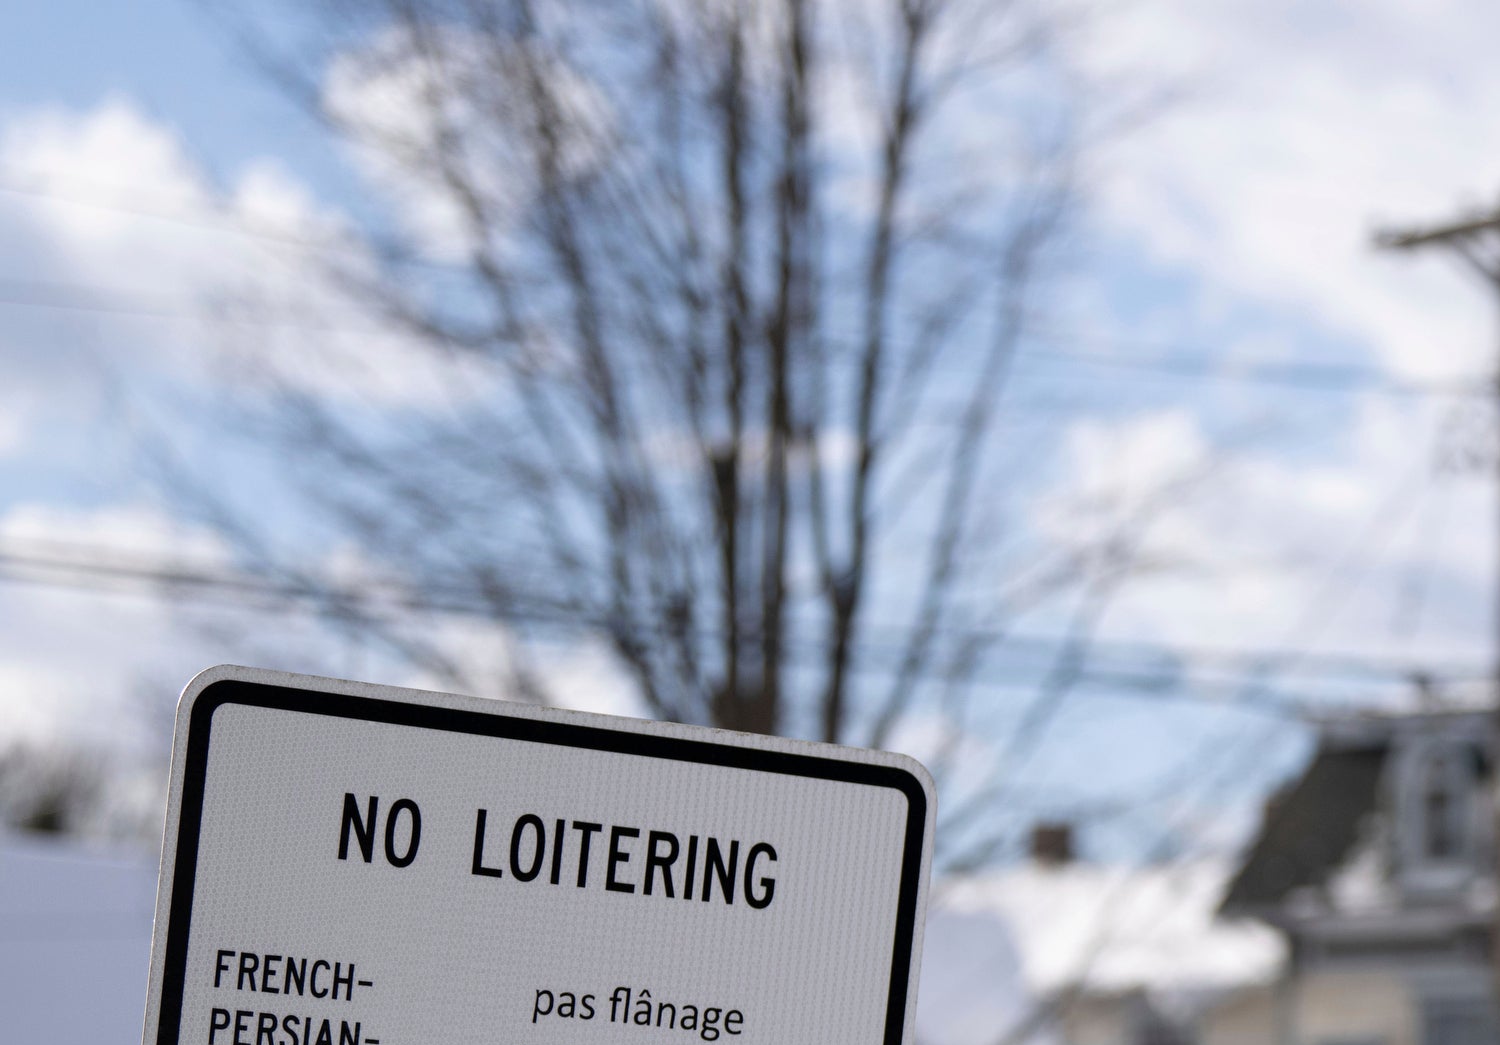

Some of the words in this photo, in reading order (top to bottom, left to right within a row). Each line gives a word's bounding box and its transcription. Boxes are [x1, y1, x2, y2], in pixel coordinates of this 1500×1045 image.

[337, 792, 422, 869] NO
[471, 808, 778, 910] LOITERING
[213, 949, 374, 1002] FRENCH-
[532, 989, 596, 1024] pas
[608, 986, 744, 1042] flânage
